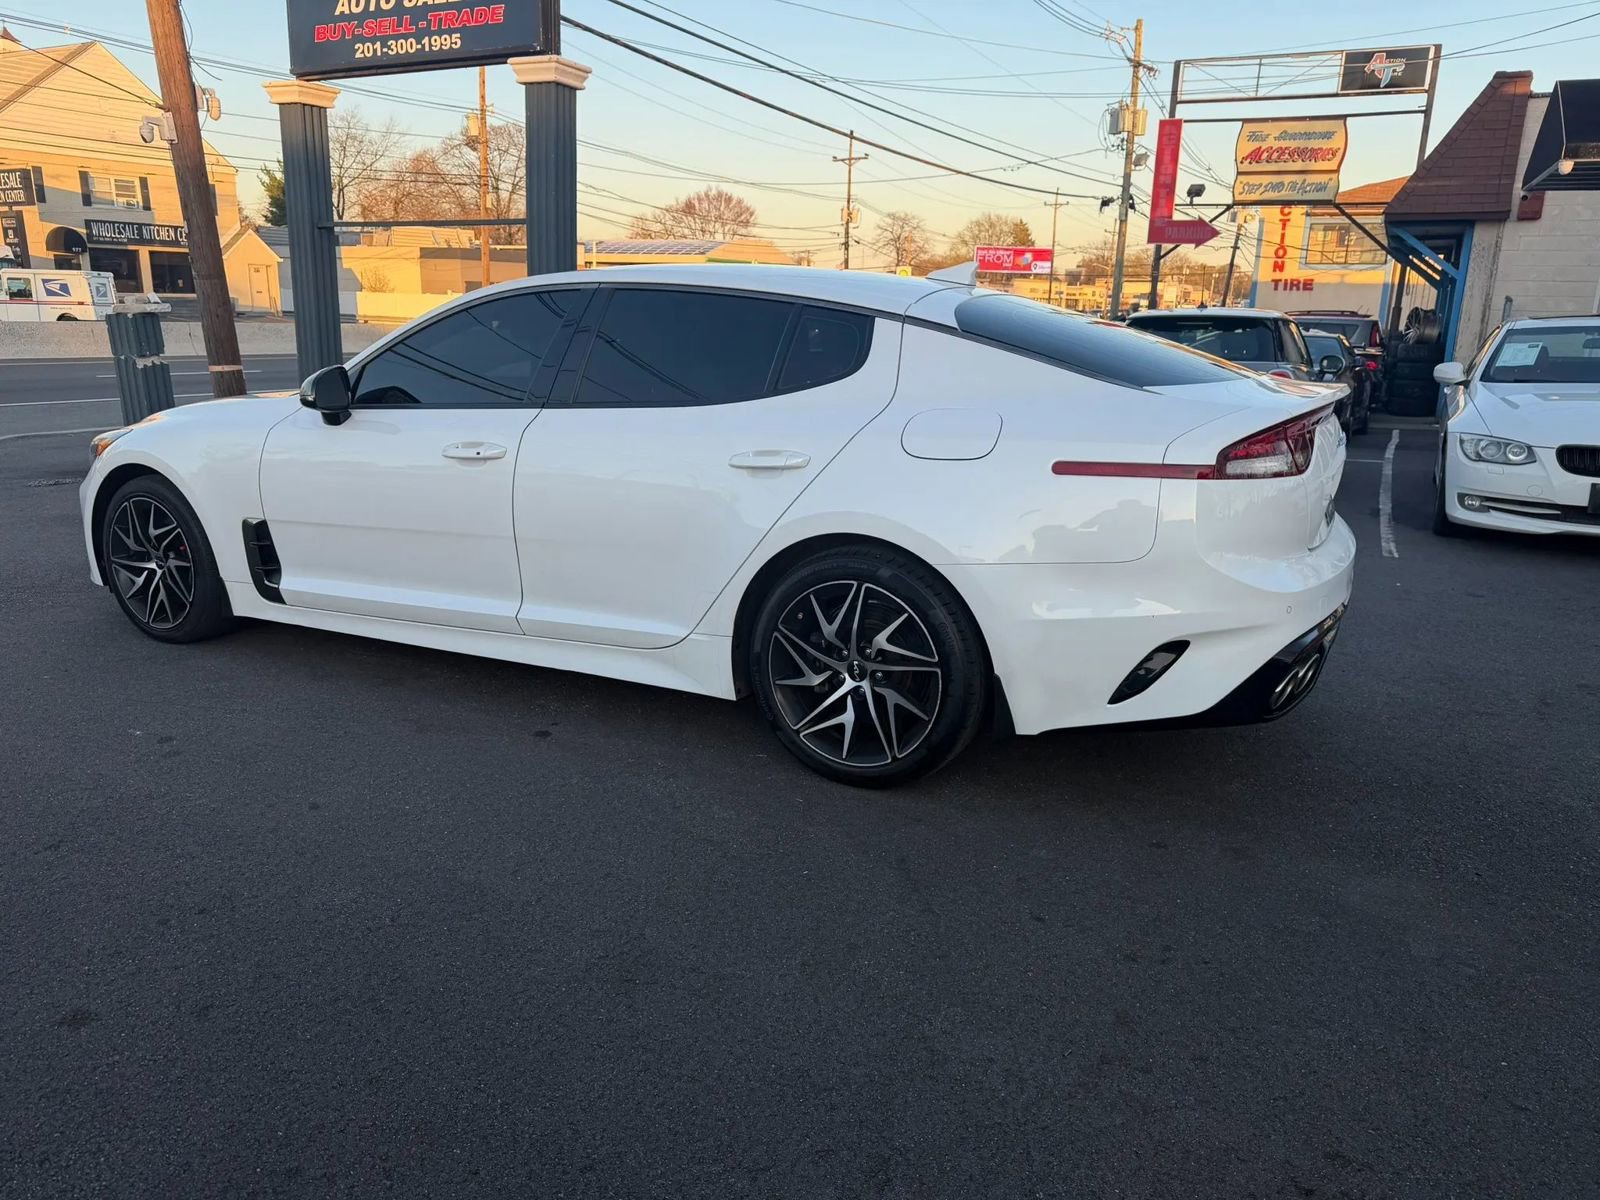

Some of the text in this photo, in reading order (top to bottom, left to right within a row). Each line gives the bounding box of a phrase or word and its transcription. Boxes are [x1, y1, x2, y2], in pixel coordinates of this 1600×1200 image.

[334, 0, 394, 15] AUTO
[354, 33, 462, 58] 201-300-1995
[1240, 145, 1341, 164] ACCESSORIES
[90, 221, 140, 239] WHOLESALE
[141, 225, 174, 241] KITCHEN
[976, 253, 1013, 265] FROM
[1271, 278, 1315, 291] TIRE
